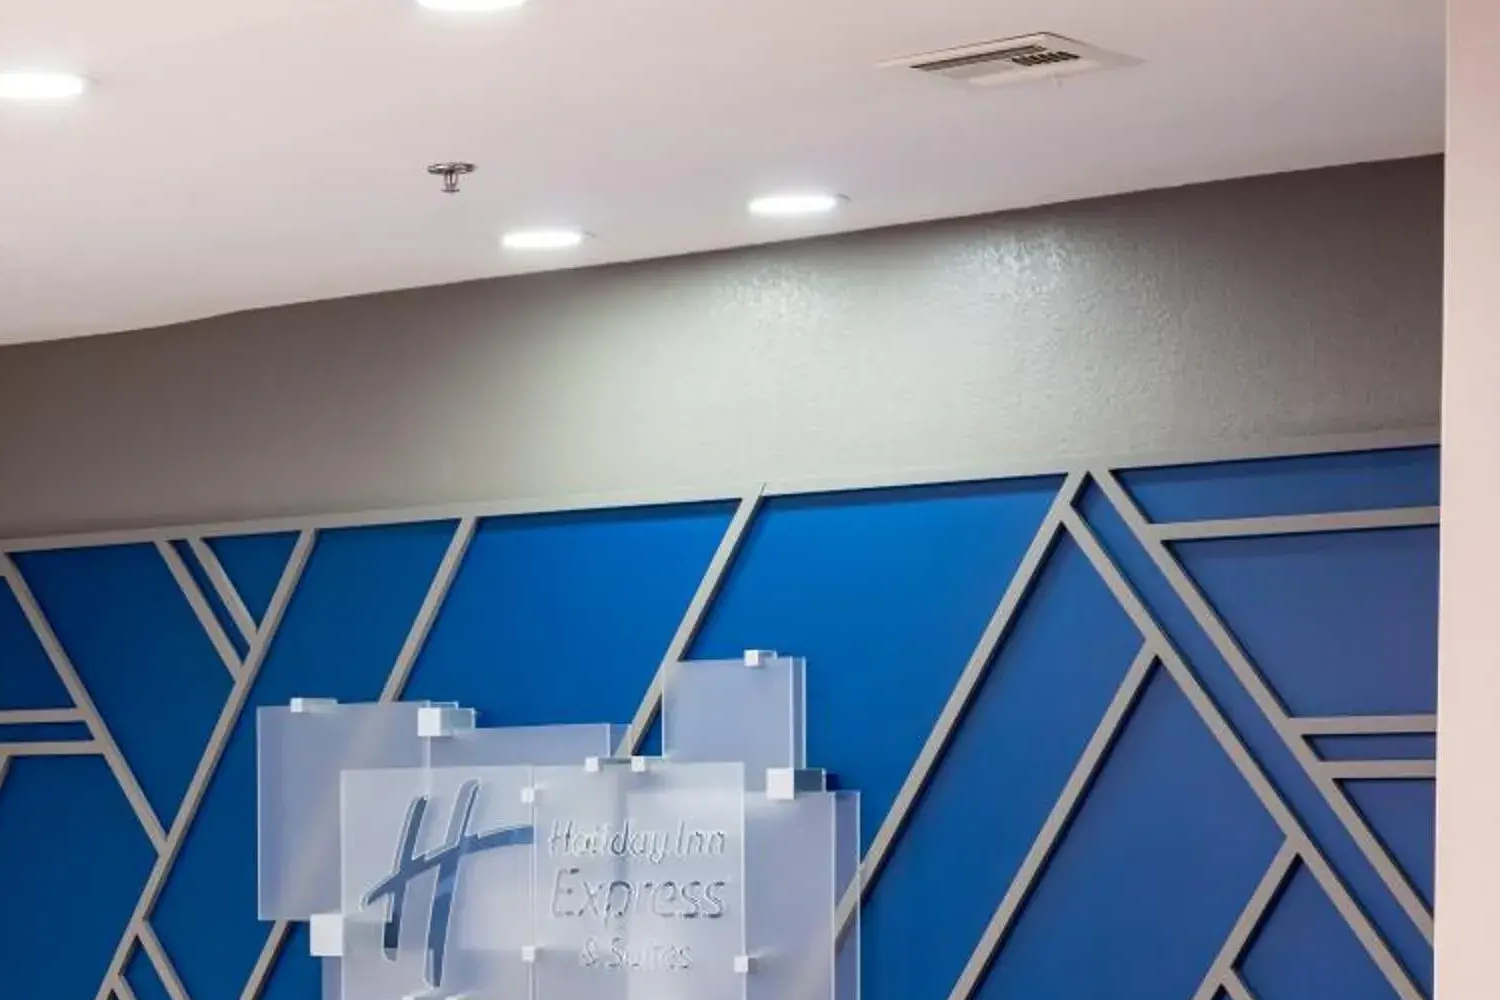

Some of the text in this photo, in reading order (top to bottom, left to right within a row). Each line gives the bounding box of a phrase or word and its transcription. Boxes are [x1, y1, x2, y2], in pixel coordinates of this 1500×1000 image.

[548, 820, 727, 865] Holiday Inn
[551, 867, 727, 928] Express
[579, 935, 694, 970] & Suites
